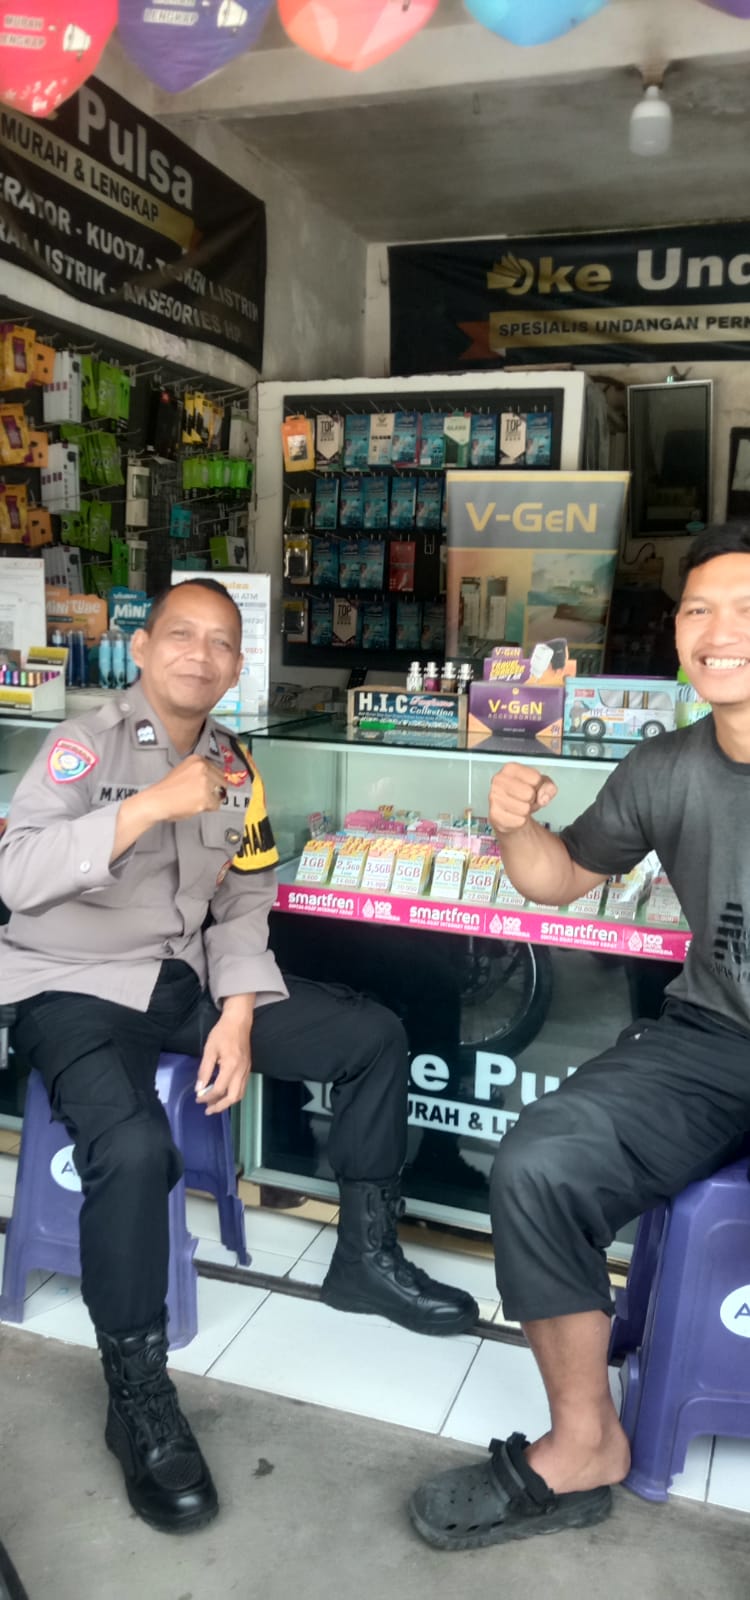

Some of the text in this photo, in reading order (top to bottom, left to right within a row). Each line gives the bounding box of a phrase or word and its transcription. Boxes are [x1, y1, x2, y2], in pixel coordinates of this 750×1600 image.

[0, 34, 45, 47] ENGKAP
[77, 85, 193, 211] Pulsa
[1, 112, 160, 223] MURAH & LENGKAP
[0, 174, 71, 235] RATOR
[87, 222, 144, 270] KUOTA
[499, 319, 588, 337] SPESIALIS
[595, 316, 699, 334] UNDANGAN
[302, 856, 324, 869] 1GB
[396, 864, 421, 878] 5GB
[435, 869, 460, 881] 7GB
[467, 875, 492, 887] 3GB
[288, 892, 354, 910] smartfren
[410, 905, 480, 925] smartfren
[541, 921, 618, 942] smartfren
[474, 1050, 578, 1106] Pu
[468, 1111, 483, 1132] &
